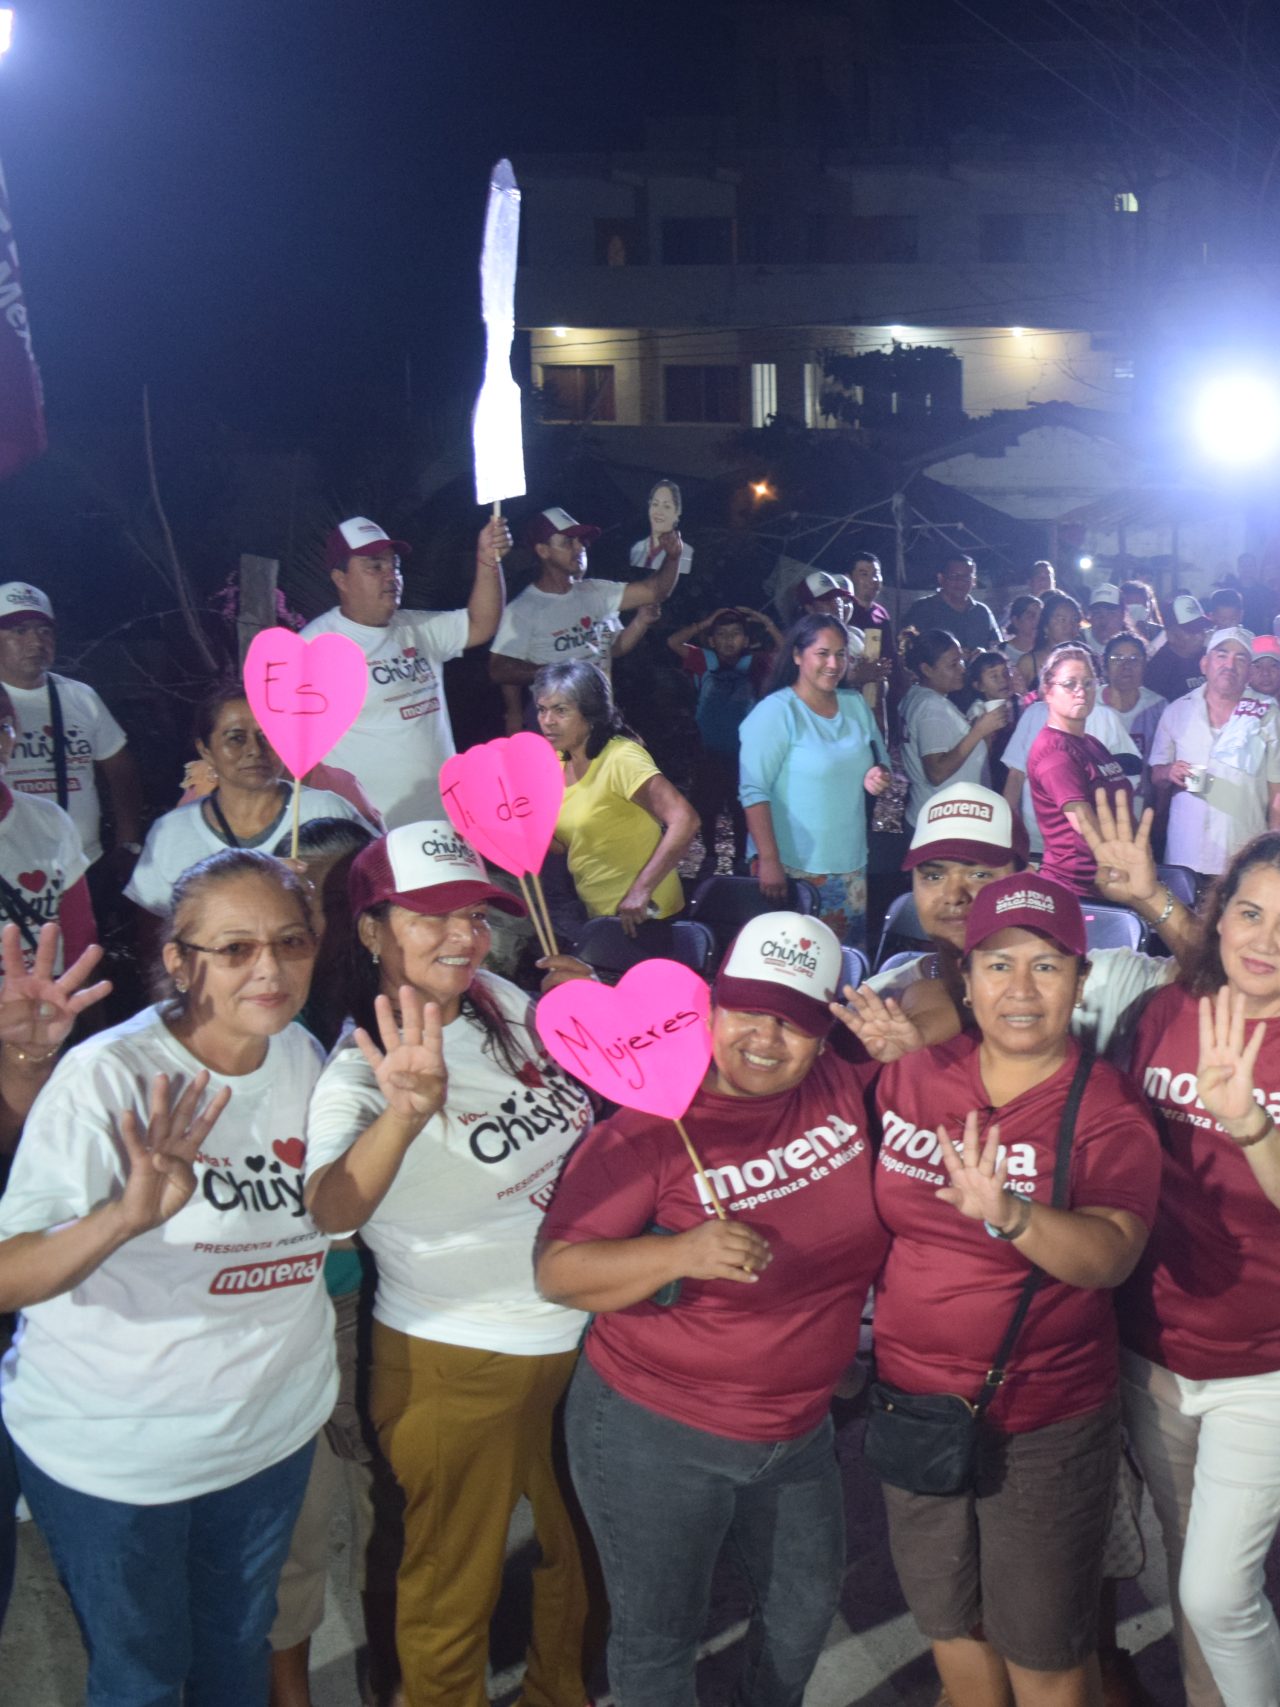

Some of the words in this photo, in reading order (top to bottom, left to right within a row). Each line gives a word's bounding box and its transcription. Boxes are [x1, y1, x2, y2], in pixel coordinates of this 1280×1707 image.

[264, 661, 329, 715] Es
[497, 776, 533, 821] de
[929, 803, 990, 819] morena
[555, 1015, 700, 1090] Mujeres
[693, 1114, 858, 1206] morena
[729, 1176, 810, 1212] esperanza
[810, 1164, 830, 1181] de
[194, 1241, 273, 1254] PRESIDENTA
[215, 1258, 319, 1290] morena
